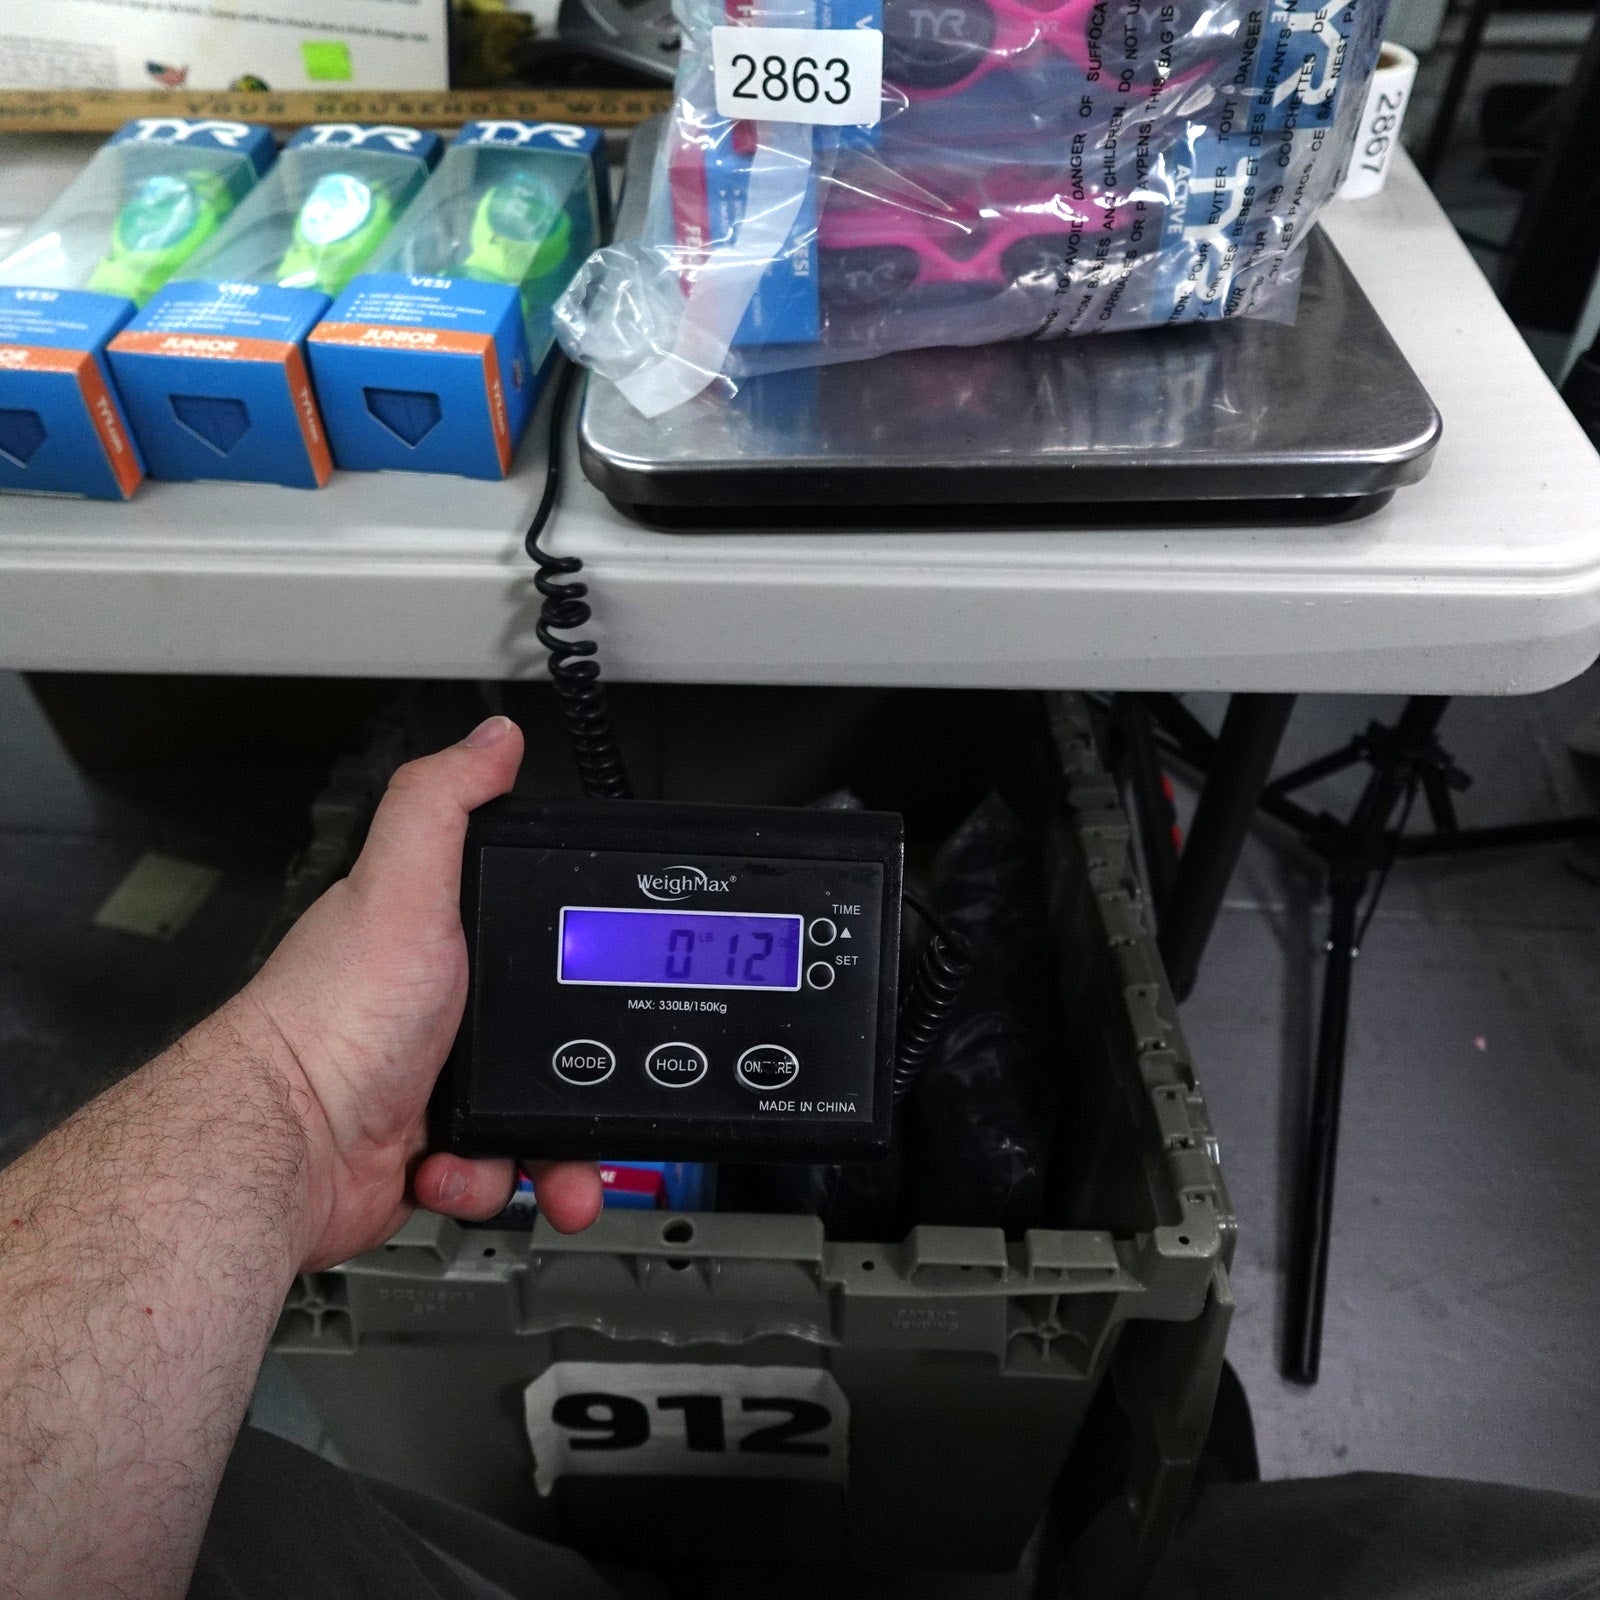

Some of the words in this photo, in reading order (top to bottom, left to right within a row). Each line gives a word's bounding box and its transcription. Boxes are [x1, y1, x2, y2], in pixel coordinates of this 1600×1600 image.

[909, 8, 966, 39] TYR
[1161, 4, 1174, 23] IS
[1124, 24, 1138, 60] NOT
[1158, 30, 1174, 67] BAG
[731, 53, 852, 105] 2863
[1118, 69, 1134, 92] DO
[1145, 77, 1166, 113] THIS
[1316, 87, 1337, 121] SAC
[1265, 184, 1284, 213] LES
[1278, 52, 1317, 168] COUCHETTES
[1312, 9, 1328, 35] DE
[136, 118, 250, 147] TYR
[310, 123, 423, 151] TYR
[475, 119, 587, 148] TYR
[1249, 113, 1266, 147] DES
[1311, 129, 1326, 152] CE
[1055, 278, 1071, 296] TO
[1071, 132, 1087, 200] DANGER
[1079, 95, 1094, 117] OF
[1087, 0, 1108, 82] SUFFOCA
[1188, 243, 1211, 282] POUR
[1208, 165, 1227, 225] EVITER
[1218, 100, 1238, 144] TOUT
[1234, 10, 1263, 85] DANGER
[1246, 155, 1260, 177] ET
[1232, 185, 1256, 237] BEBES
[1131, 220, 1146, 242] OR
[1282, 222, 1294, 251] LES
[1219, 244, 1239, 272] DES
[410, 276, 453, 289] VESI
[160, 336, 238, 352] JUNIOR
[363, 328, 438, 344] JUNIOR
[831, 904, 861, 916] TIME
[725, 931, 774, 982] 12
[835, 955, 859, 966] SET
[627, 999, 656, 1010] MAX:
[659, 1000, 728, 1015] 330LB/150Kg
[561, 1056, 606, 1069] MODE
[656, 1059, 698, 1072] HOLD
[759, 1100, 795, 1112] MADE
[800, 1101, 812, 1113] IN
[816, 1101, 856, 1113] CHINA
[552, 1391, 832, 1457] 912
